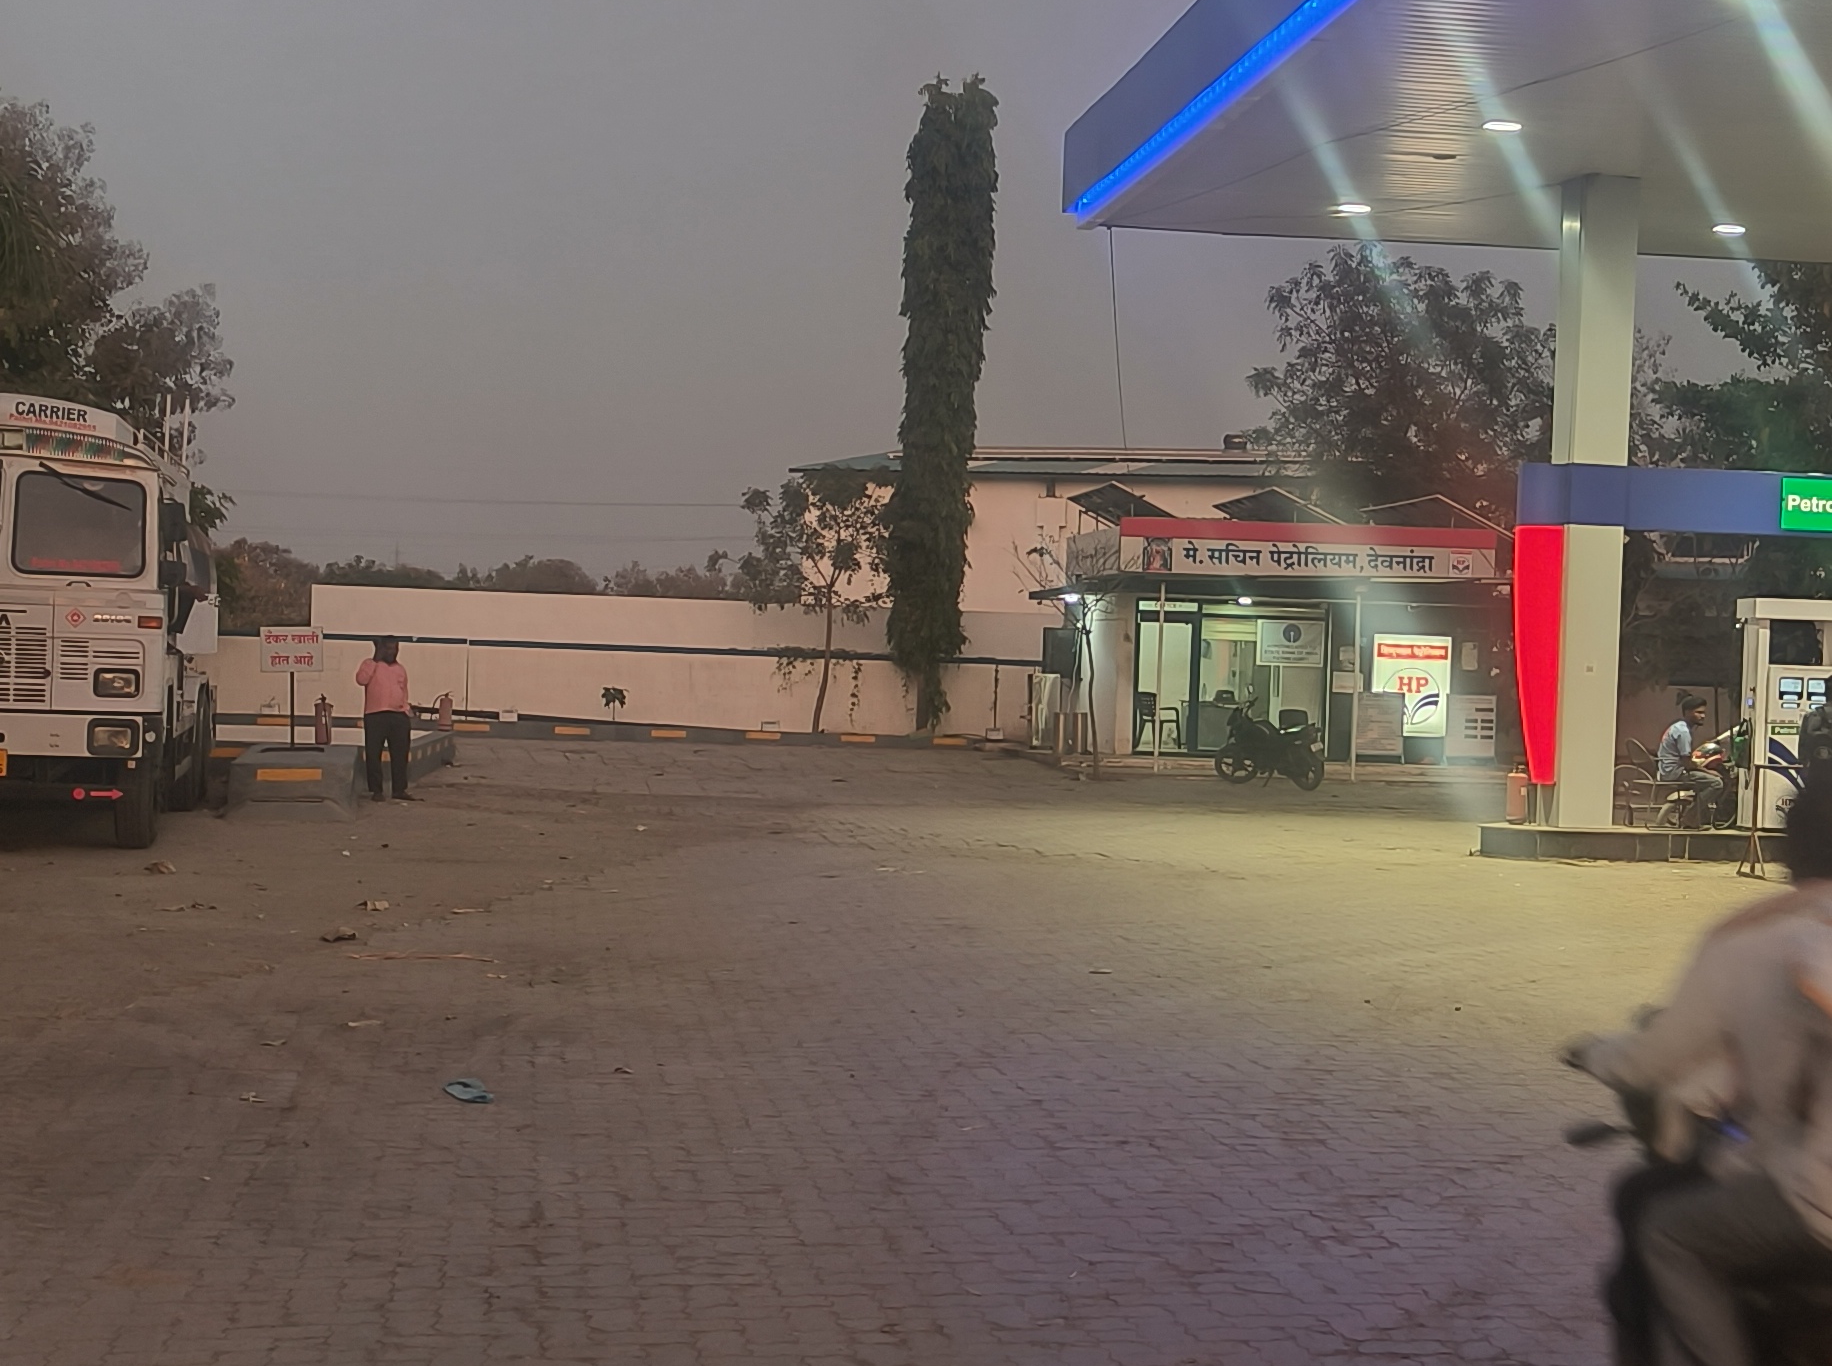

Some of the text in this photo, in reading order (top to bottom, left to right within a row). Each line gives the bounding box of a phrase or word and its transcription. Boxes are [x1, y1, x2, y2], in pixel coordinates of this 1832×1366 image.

[15, 401, 88, 423] CARRIER
[1207, 543, 1262, 567] सचिन
[291, 631, 319, 644] खाली
[270, 651, 314, 667] होत आहे
[1397, 676, 1429, 694] HP
